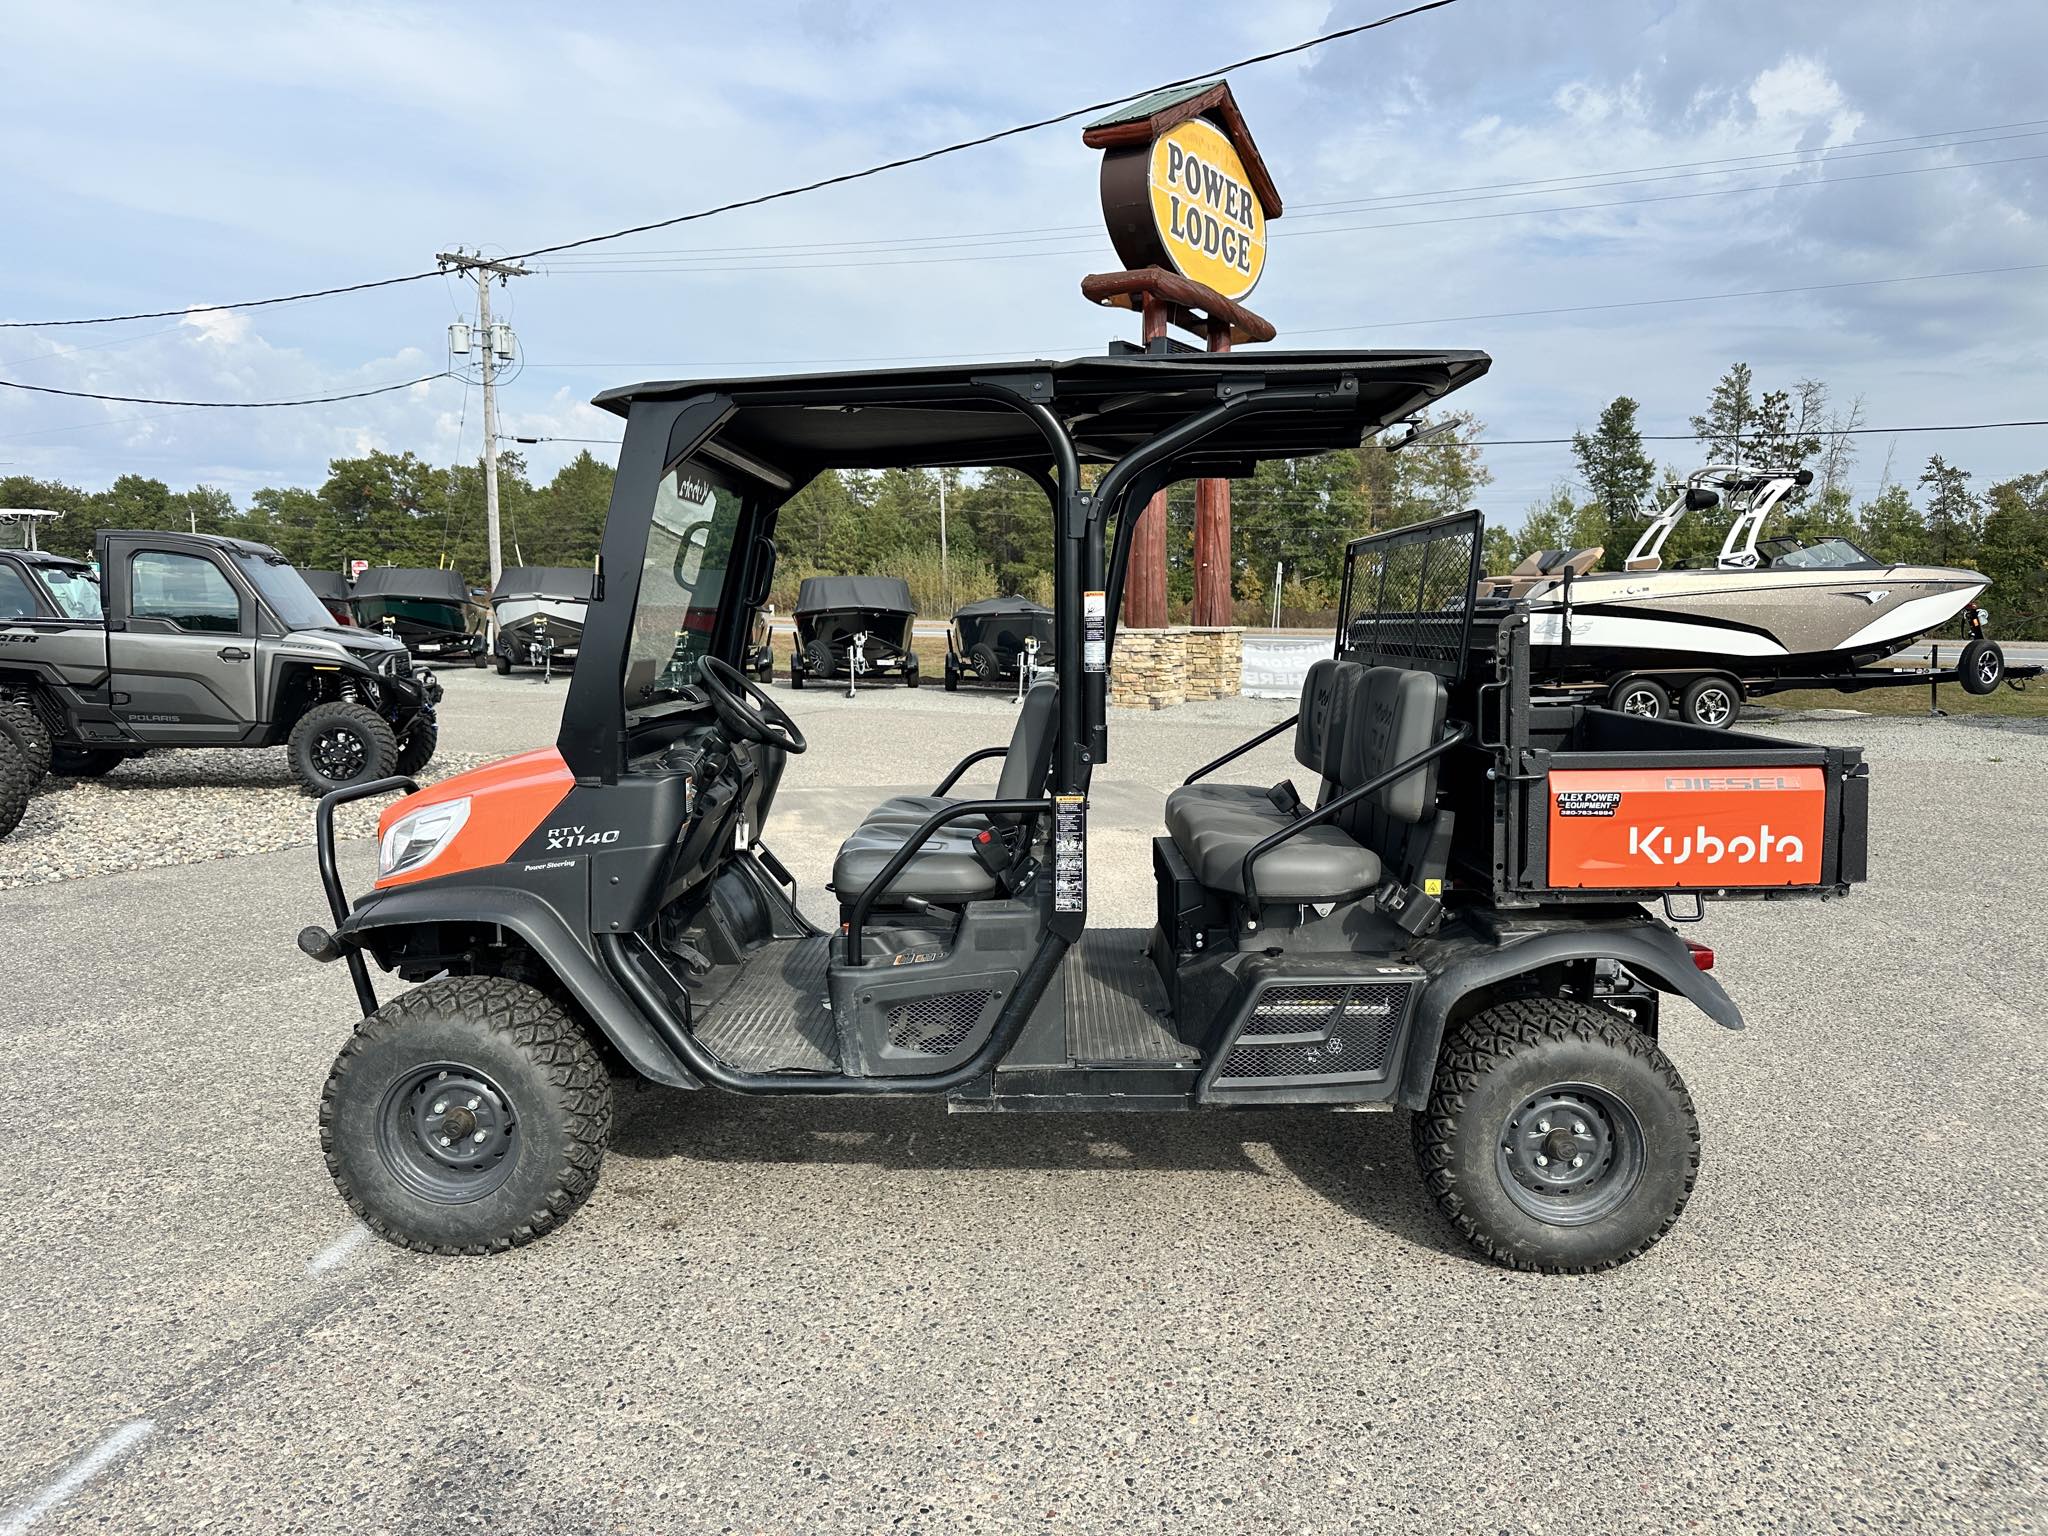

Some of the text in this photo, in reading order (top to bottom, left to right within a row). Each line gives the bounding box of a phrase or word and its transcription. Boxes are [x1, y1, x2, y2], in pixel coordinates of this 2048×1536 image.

[1167, 142, 1254, 230] POWER
[1170, 196, 1251, 273] LODGE
[128, 714, 181, 722] POLARIS
[1665, 777, 1800, 790] DIESEL
[1557, 793, 1620, 802] ALEX POWER
[547, 825, 585, 838] RTV
[545, 830, 620, 850] X1140
[1629, 824, 1803, 864] Kubota
[524, 860, 576, 872] Power Steering
